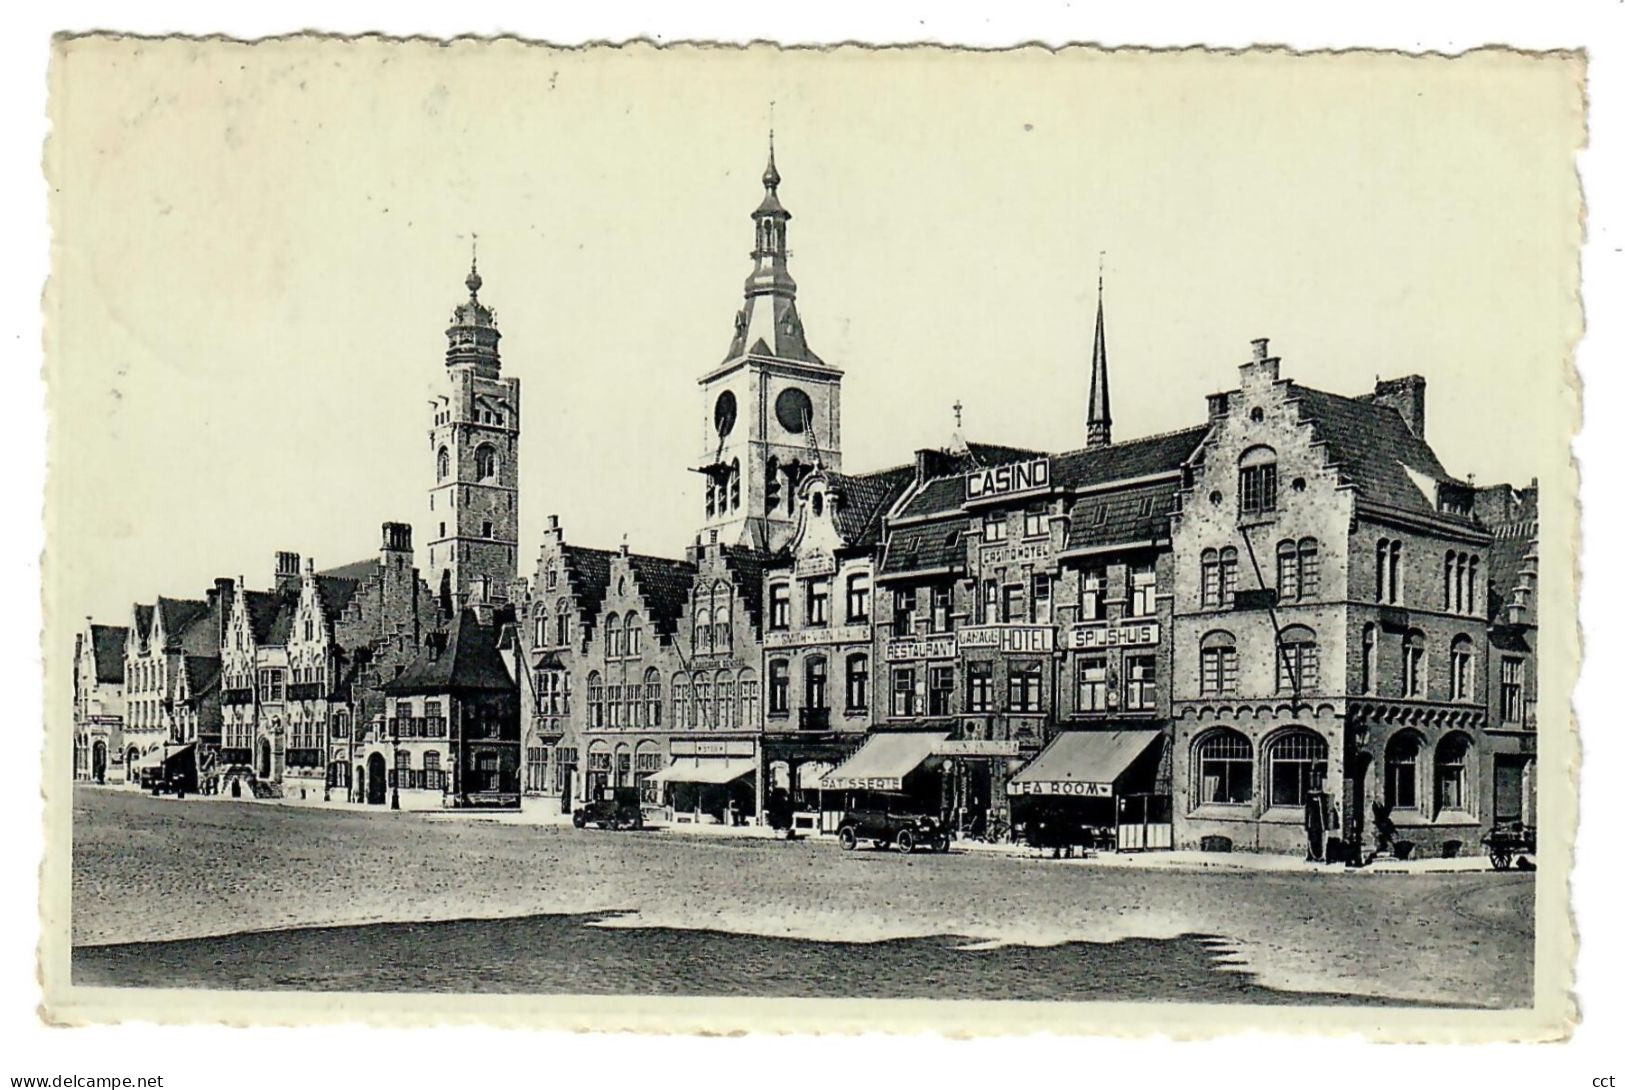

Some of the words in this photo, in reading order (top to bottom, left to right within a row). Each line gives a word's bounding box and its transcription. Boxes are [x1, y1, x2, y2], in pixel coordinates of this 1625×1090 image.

[967, 460, 1048, 499] CASINO
[1018, 545, 1048, 559] HOTEL
[958, 629, 998, 645] GARAGE
[1002, 628, 1051, 651] HOTEL
[1075, 626, 1151, 647] SPIJSHUIS
[887, 641, 954, 659] RESTAURANT
[820, 778, 900, 790] PATISSERIE
[1010, 781, 1042, 795] TEA
[1051, 781, 1099, 796] ROOM
